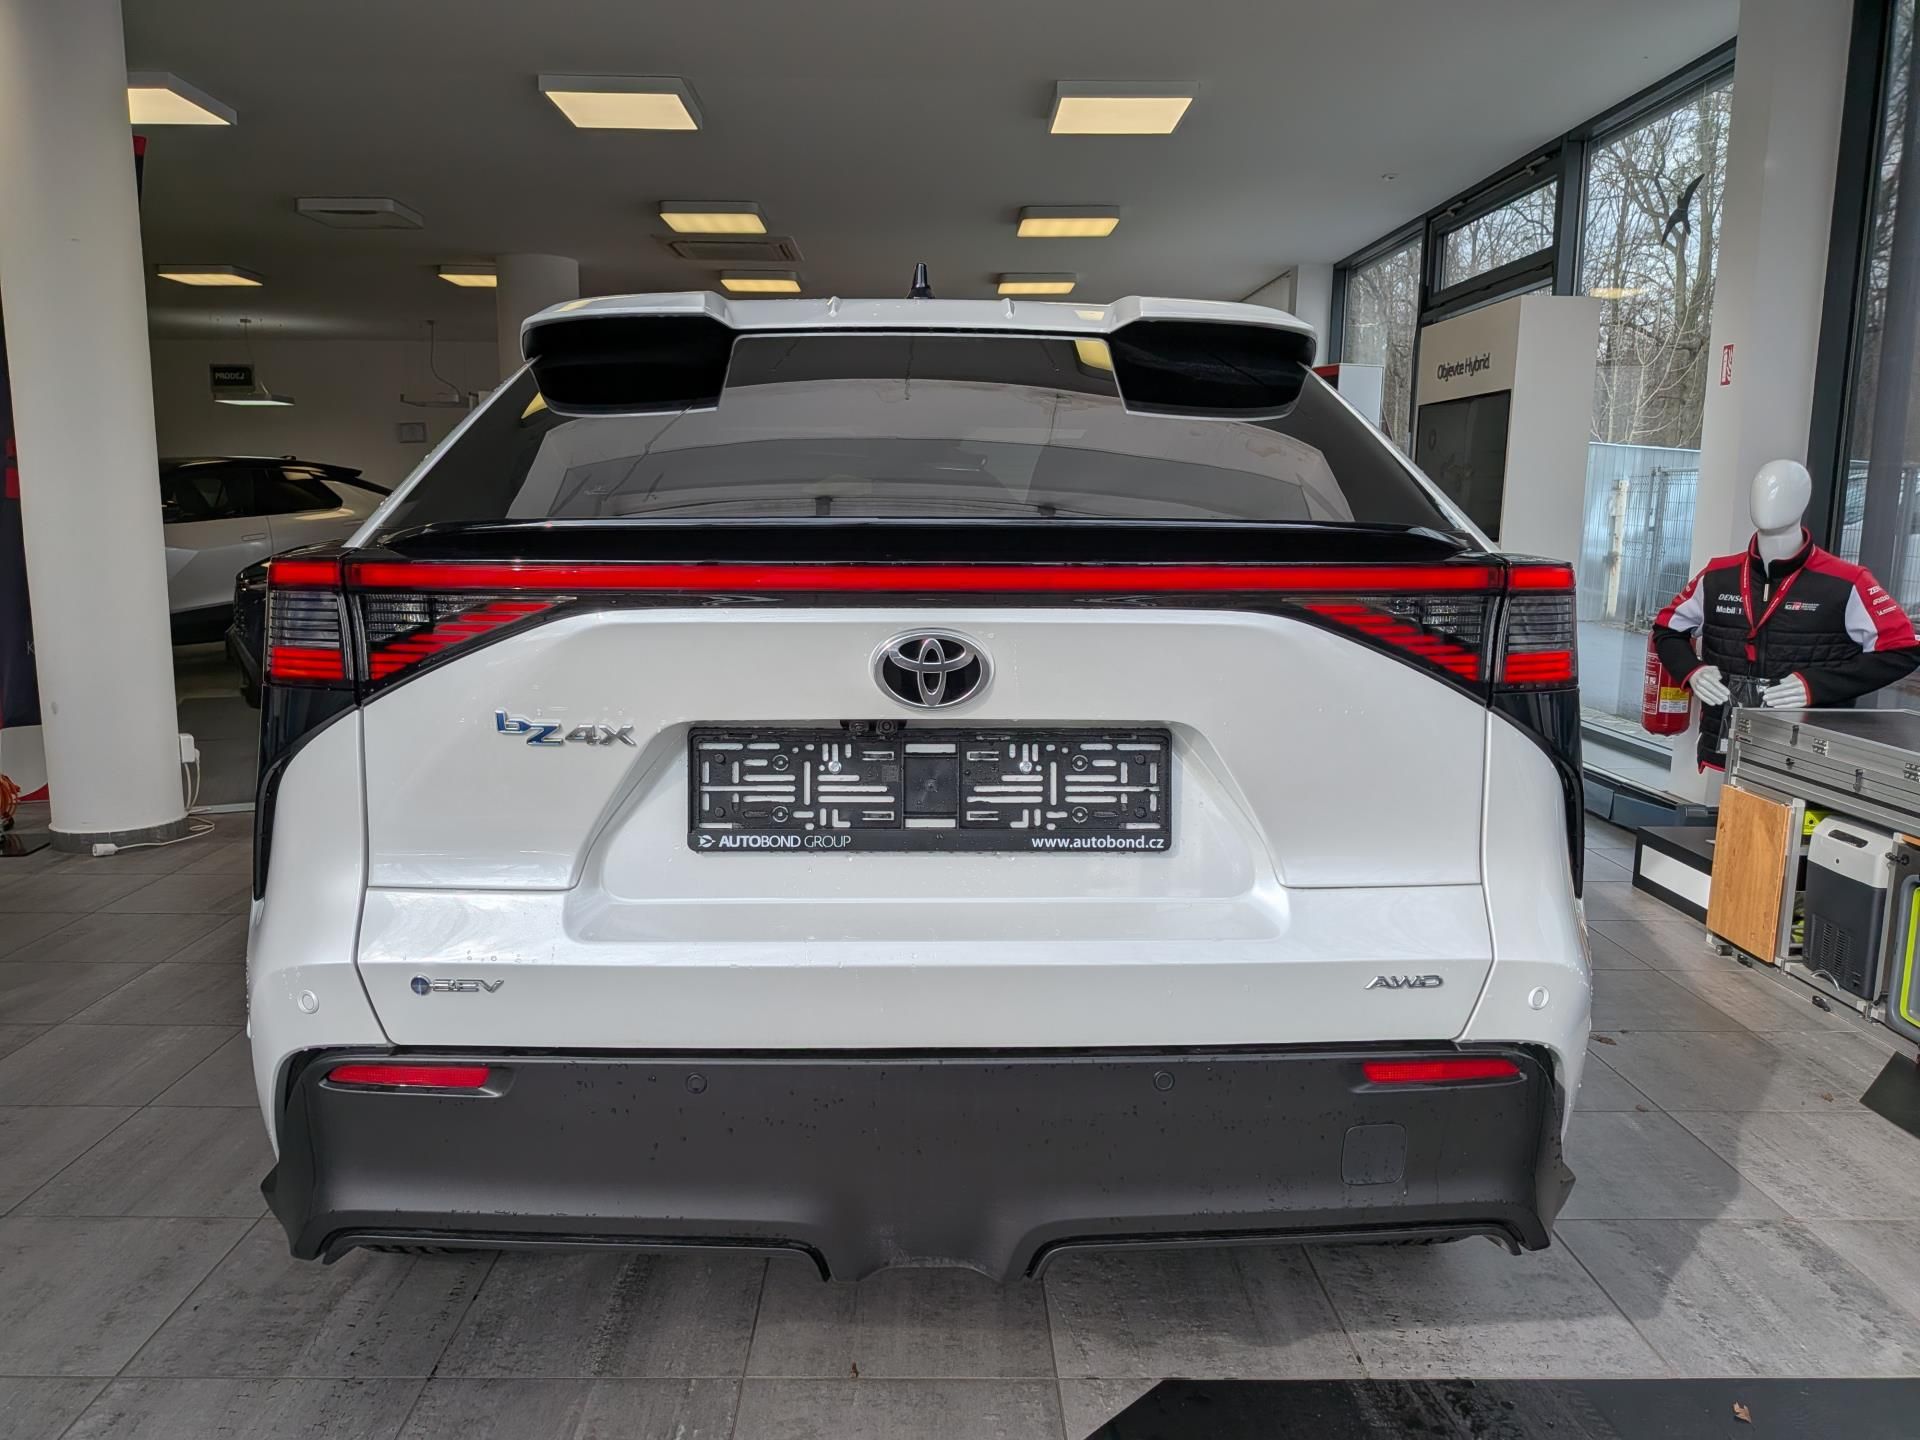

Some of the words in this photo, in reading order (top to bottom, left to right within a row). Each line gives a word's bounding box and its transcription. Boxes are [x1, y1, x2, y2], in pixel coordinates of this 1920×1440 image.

[1437, 360, 1464, 382] Objevte
[1465, 352, 1490, 376] Hybrid
[1716, 605, 1736, 614] Mobil
[495, 708, 636, 746] bZ4X
[718, 835, 801, 848] AUTOBOND
[804, 835, 851, 848] GROUP
[1031, 835, 1164, 849] www.autobond.cz
[1364, 975, 1443, 990] AWD
